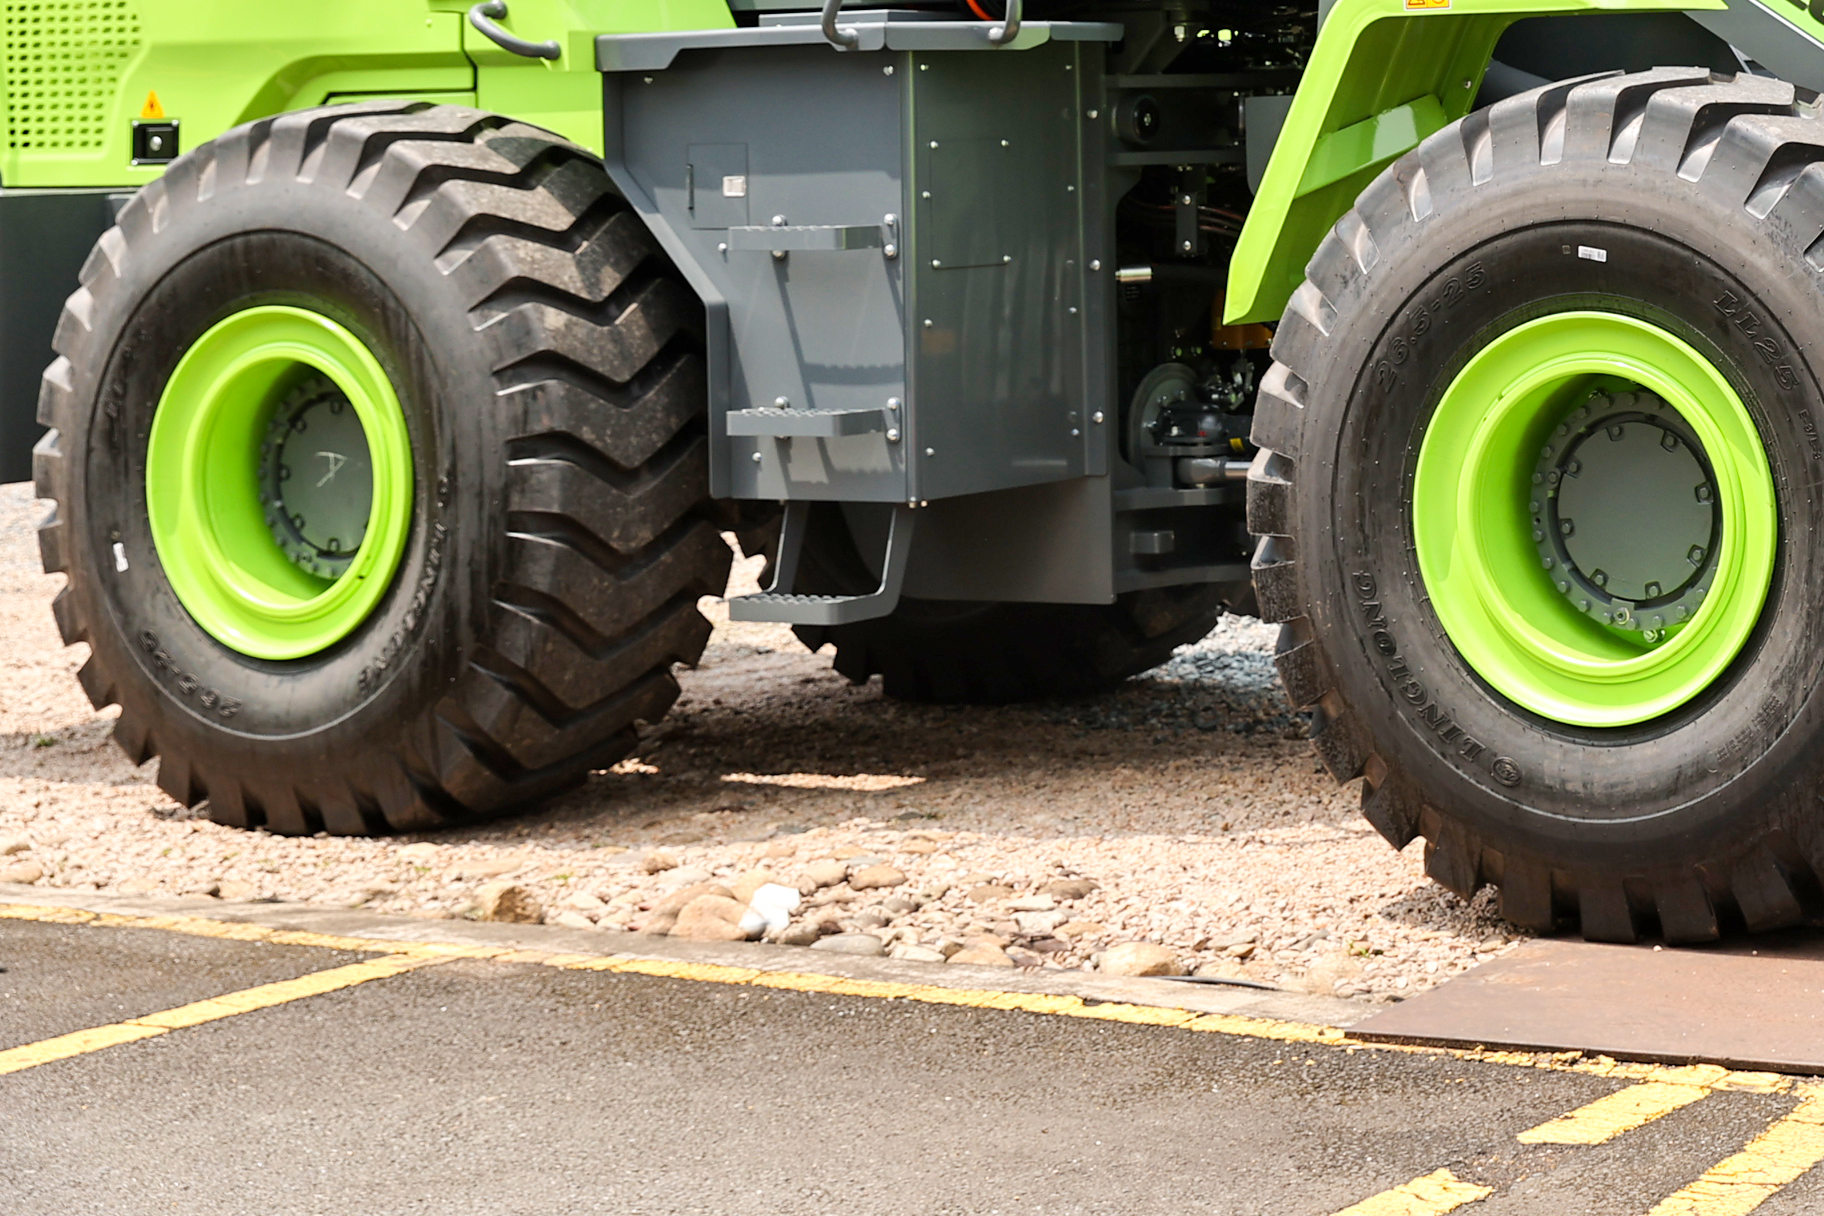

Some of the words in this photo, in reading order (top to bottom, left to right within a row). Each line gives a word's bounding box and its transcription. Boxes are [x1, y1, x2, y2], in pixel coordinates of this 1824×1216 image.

[1377, 260, 1488, 394] 26.5-25
[1712, 289, 1800, 391] LL25
[1351, 569, 1487, 763] LINGLONG
